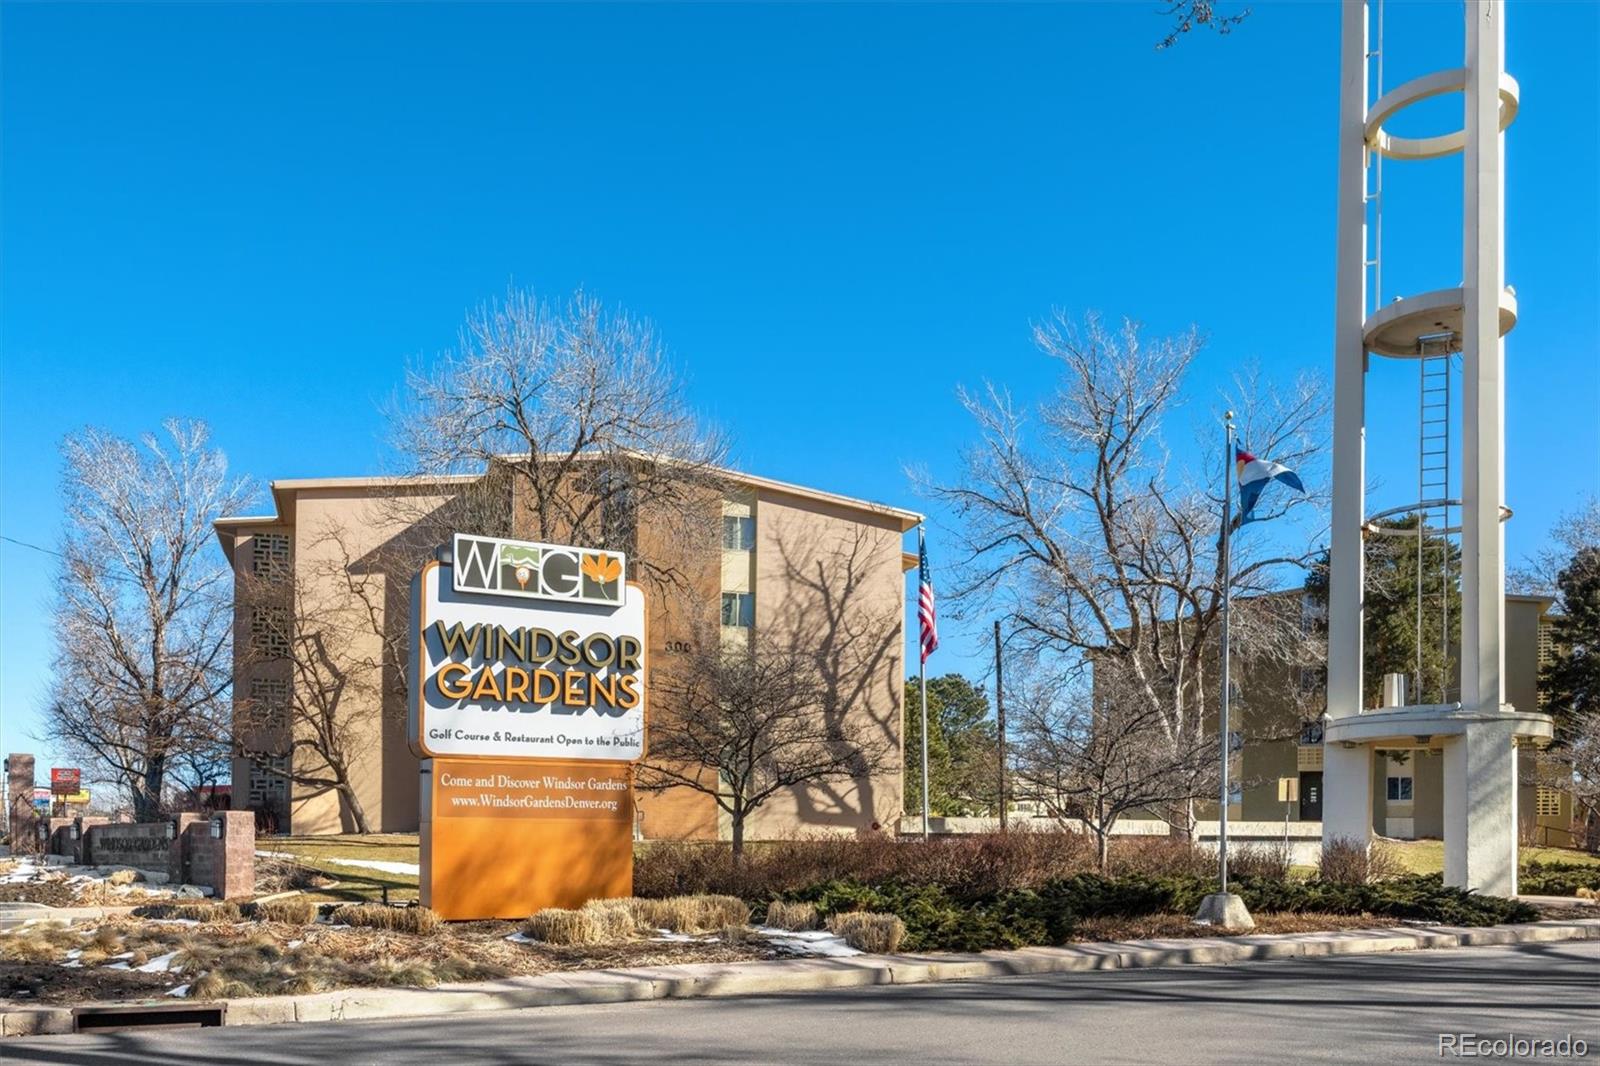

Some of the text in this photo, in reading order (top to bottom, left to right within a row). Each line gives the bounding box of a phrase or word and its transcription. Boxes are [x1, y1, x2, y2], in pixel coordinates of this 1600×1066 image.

[436, 619, 642, 670] WINDSOR
[437, 661, 641, 709] GARDENS
[429, 728, 640, 748] Golf Course & Restaurant Open to the Public
[441, 773, 628, 791] Come and Discover Windsor Gardens
[451, 793, 618, 812] www.WindsorGardensDenver.org
